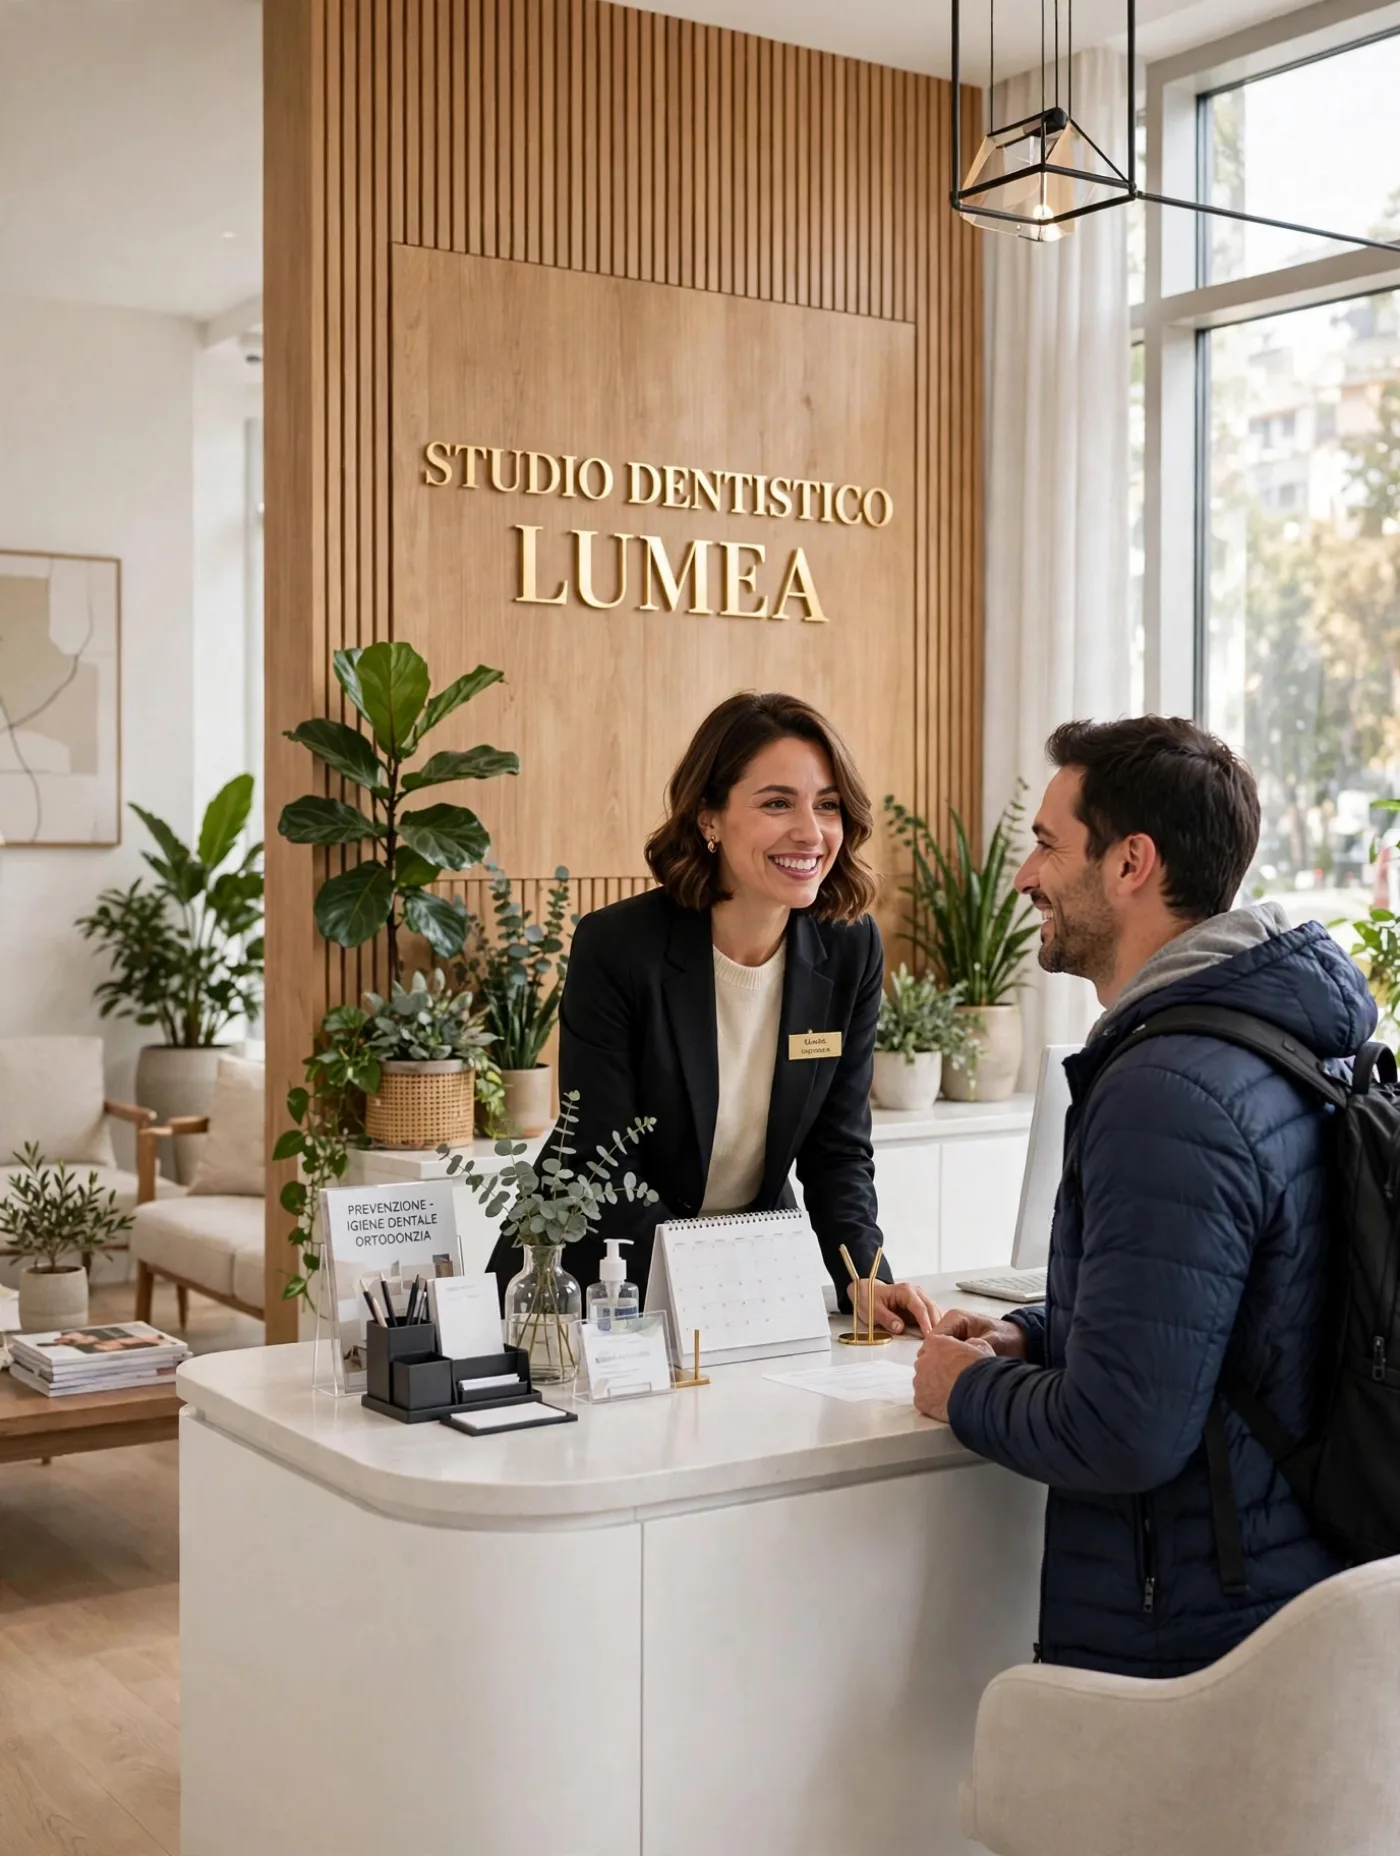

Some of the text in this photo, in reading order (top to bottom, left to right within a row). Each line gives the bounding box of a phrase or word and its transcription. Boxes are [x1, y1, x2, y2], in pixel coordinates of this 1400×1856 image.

[424, 441, 894, 528] STUDIO DENTISTICO
[513, 524, 830, 622] LUMEA
[348, 1199, 427, 1215] PREVENZIONE
[347, 1213, 438, 1231] IGIENE DENTALE
[355, 1230, 432, 1247] ORTODONZIA
